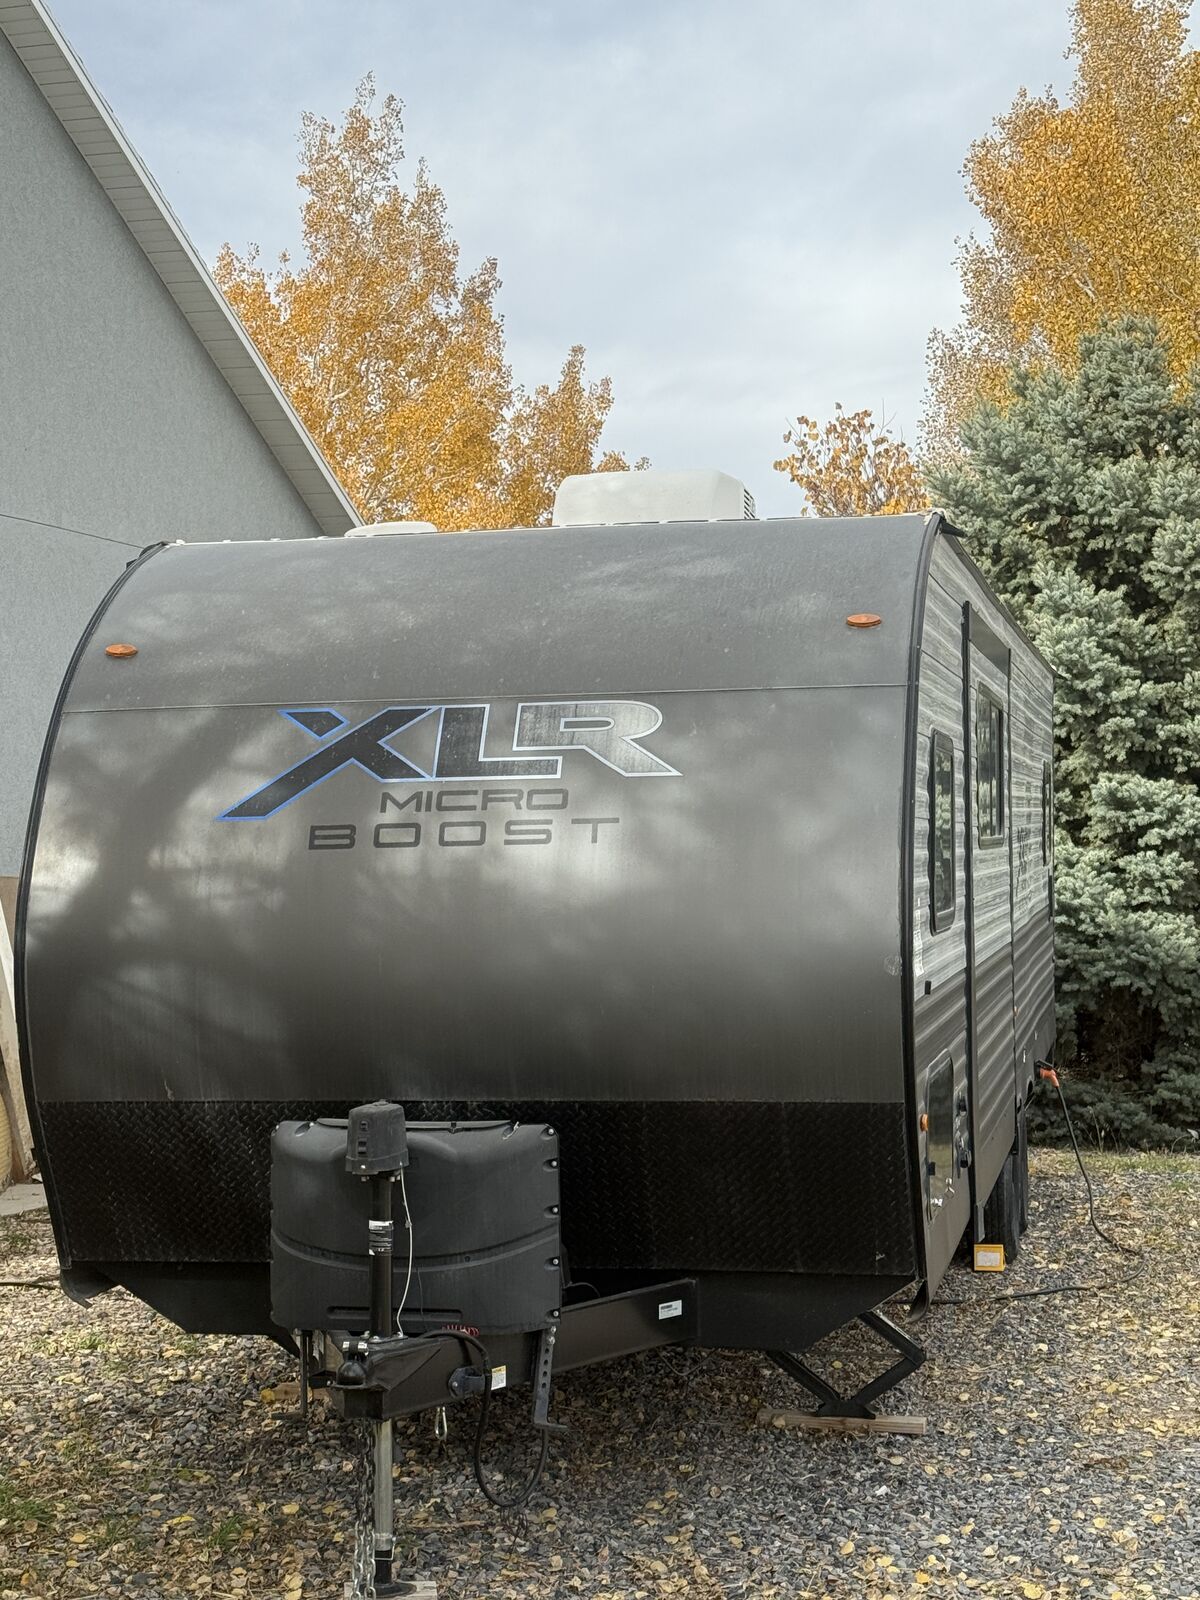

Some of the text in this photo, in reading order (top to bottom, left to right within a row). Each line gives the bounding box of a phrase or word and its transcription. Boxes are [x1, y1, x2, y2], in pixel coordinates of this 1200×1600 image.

[215, 701, 683, 820] XLR
[379, 788, 569, 813] MICRO
[308, 818, 620, 850] BOOST
